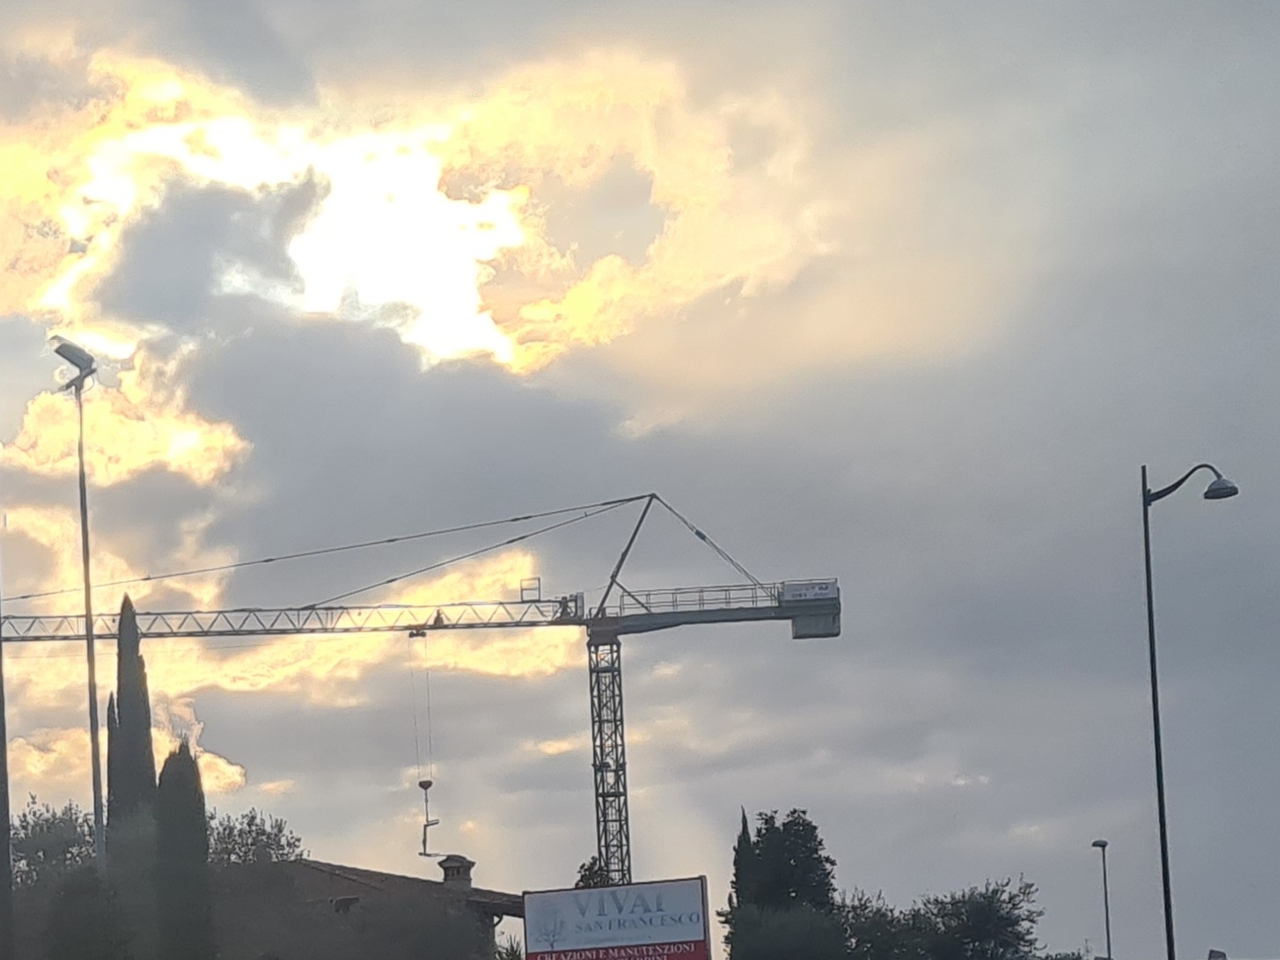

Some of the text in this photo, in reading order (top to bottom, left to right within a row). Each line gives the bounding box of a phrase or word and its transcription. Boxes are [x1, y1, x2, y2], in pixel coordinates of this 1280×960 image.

[573, 889, 666, 917] VIVAI
[575, 912, 701, 933] SAN FRANCESCO
[599, 949, 607, 959] E
[608, 943, 695, 959] MANUTENZIONI
